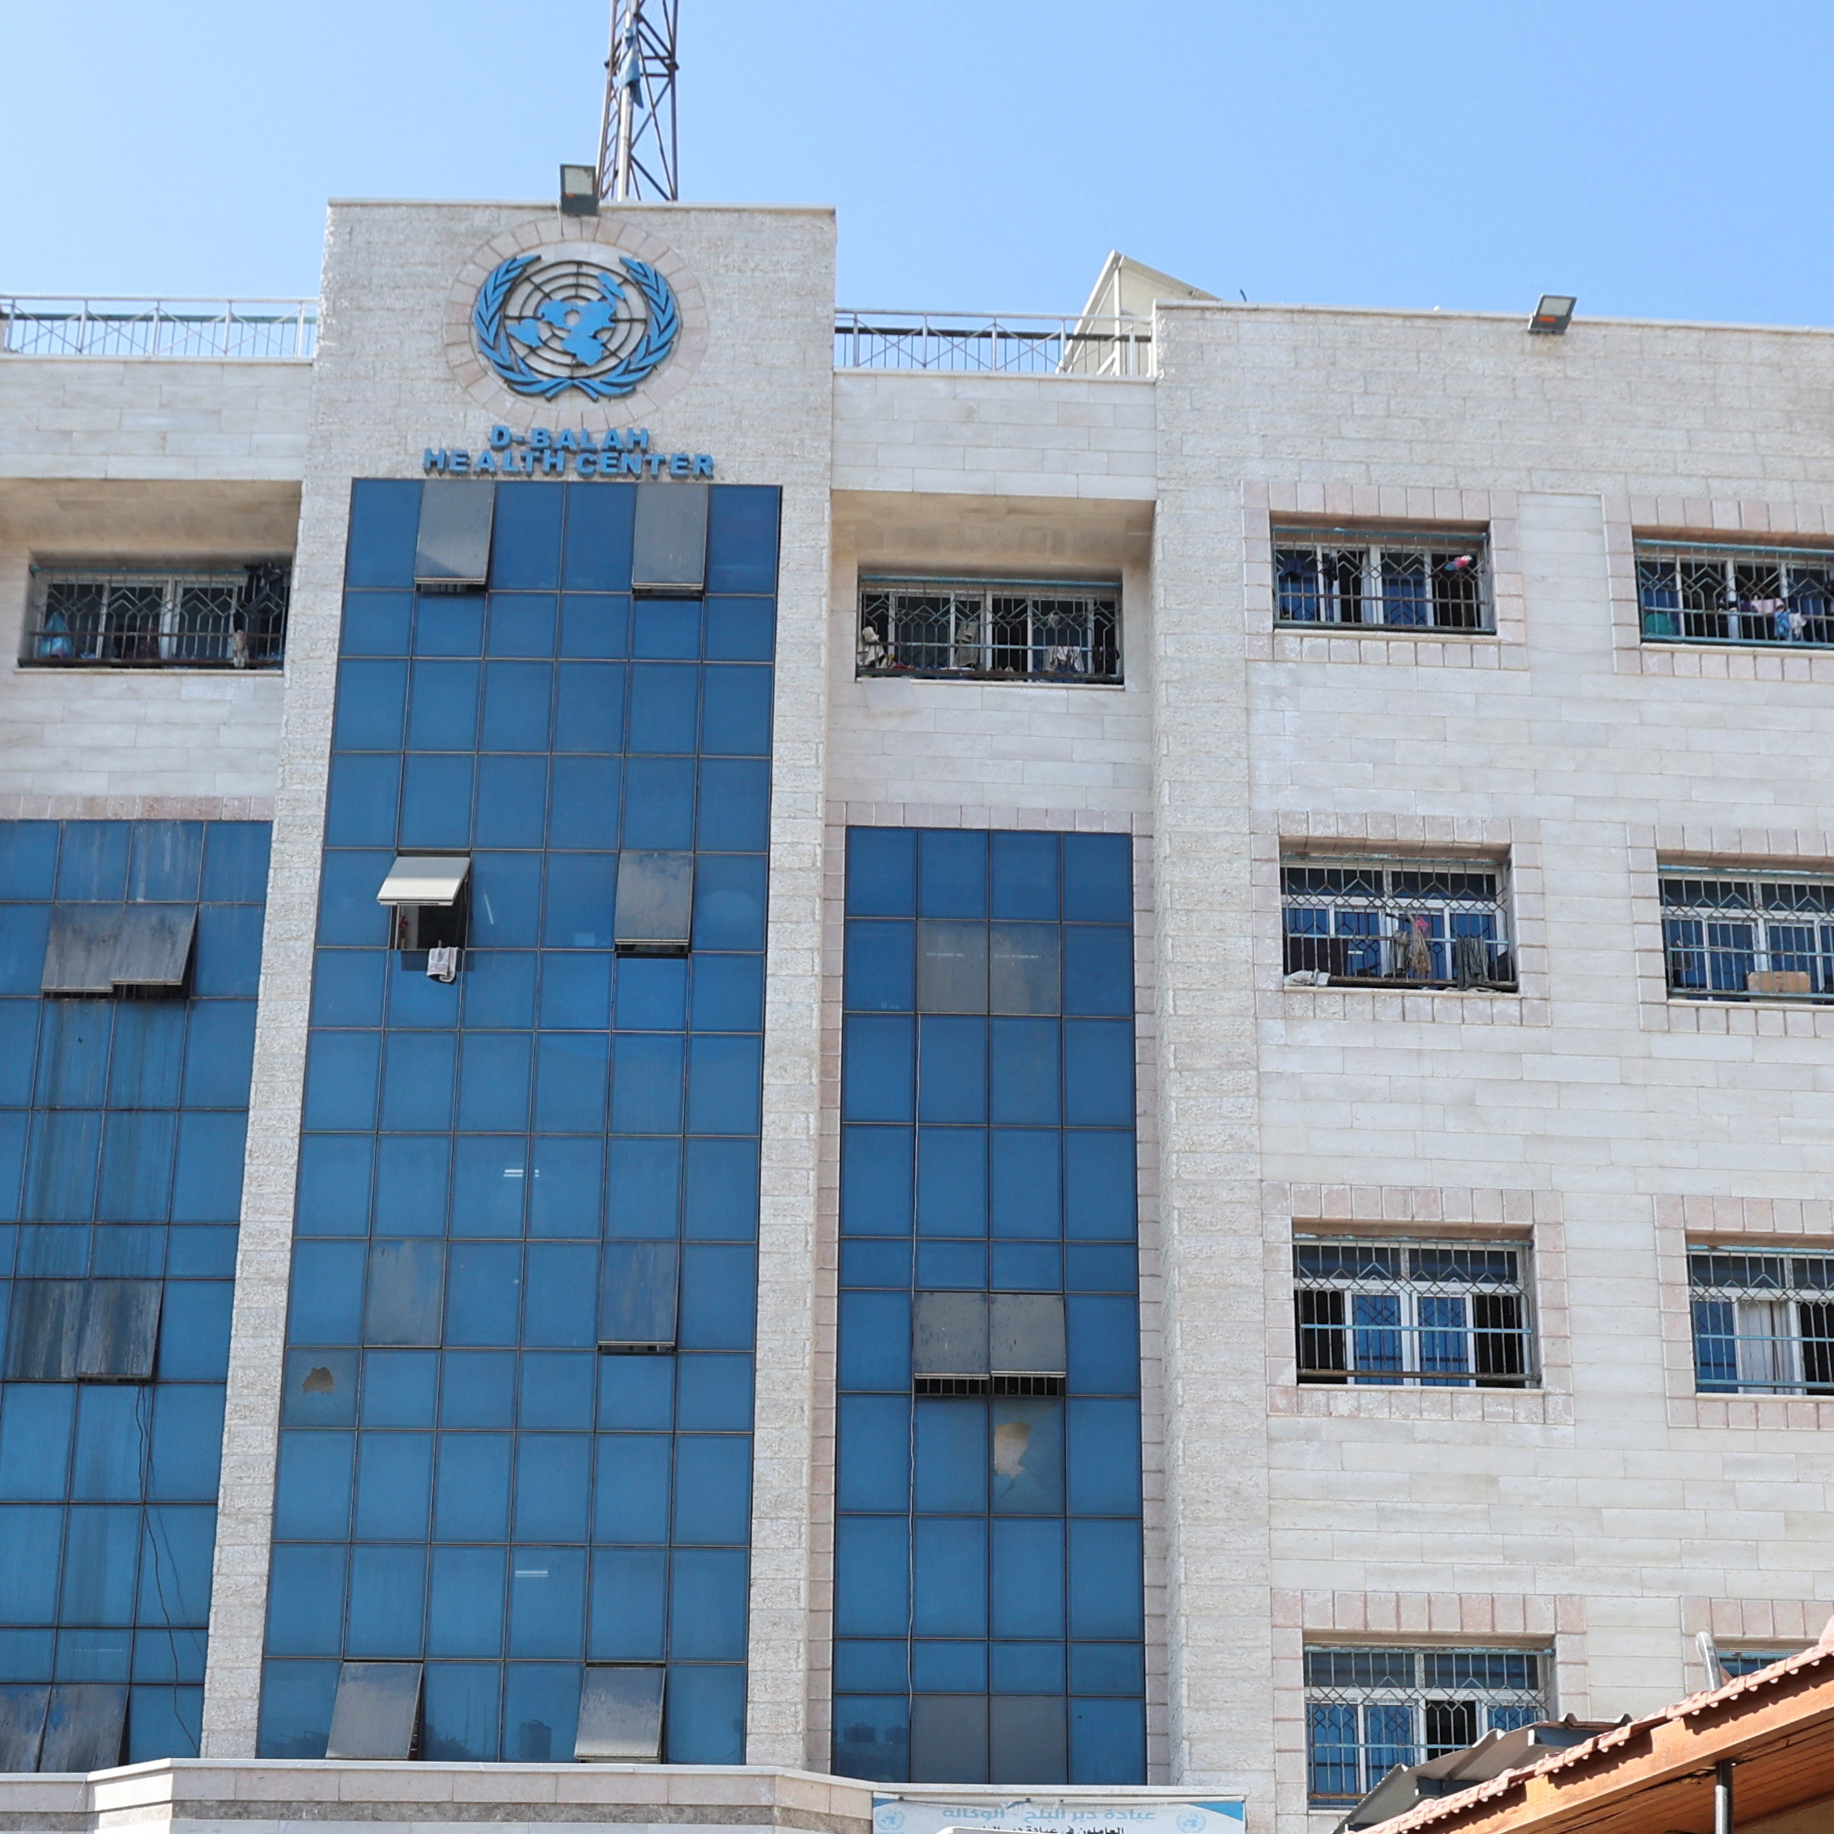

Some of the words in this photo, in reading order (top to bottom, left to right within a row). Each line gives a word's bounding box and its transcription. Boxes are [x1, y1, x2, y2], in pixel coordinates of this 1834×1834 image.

[490, 425, 650, 452] D-BALAH
[423, 447, 567, 475] HEALTH
[574, 450, 715, 479] CENTER
[942, 1807, 1006, 1822] الوكالة
[1024, 1808, 1066, 1823] البلح
[1072, 1808, 1098, 1823] دير
[1104, 1808, 1156, 1823] عيادة
